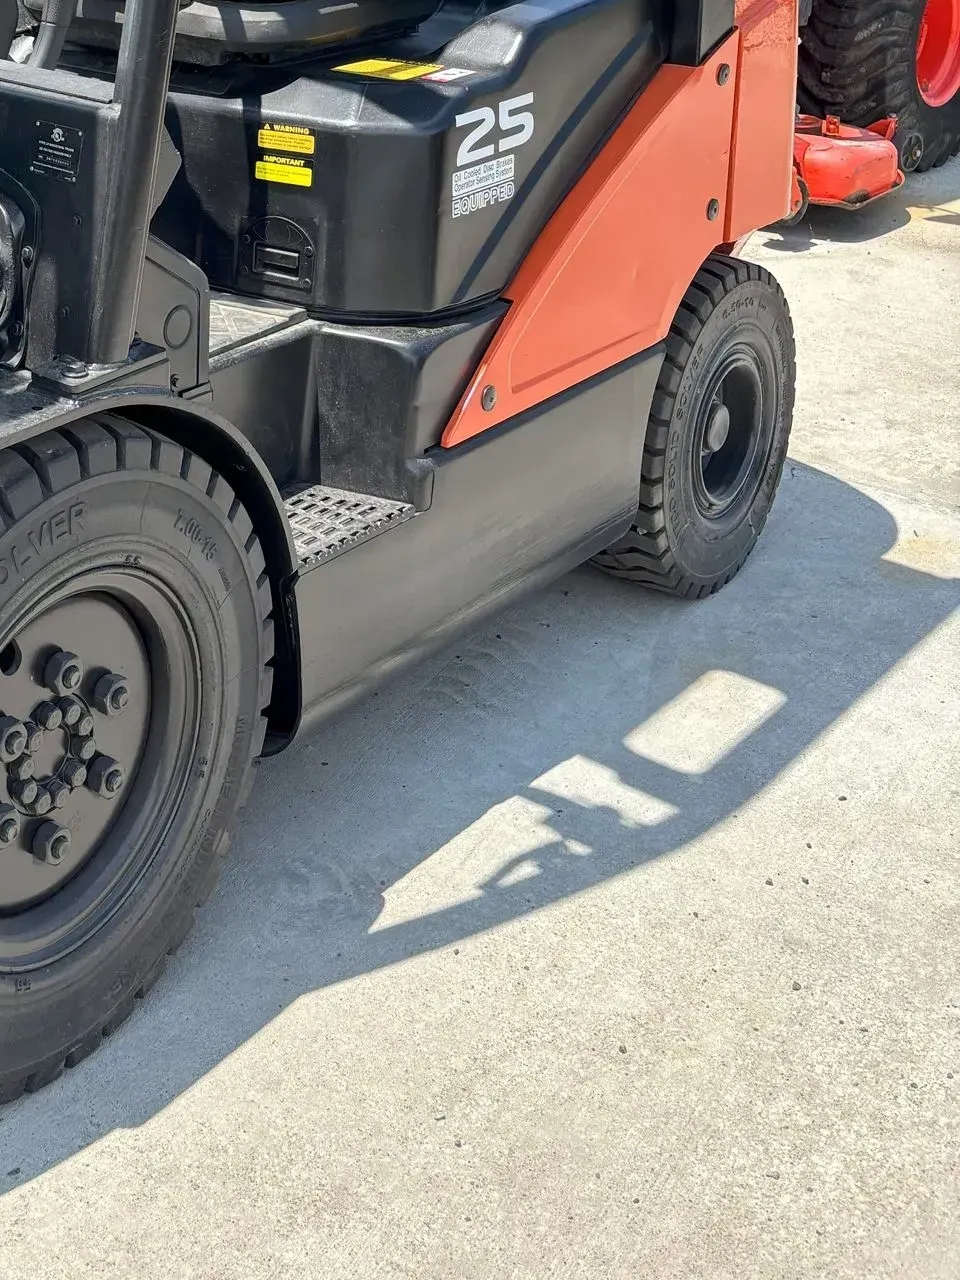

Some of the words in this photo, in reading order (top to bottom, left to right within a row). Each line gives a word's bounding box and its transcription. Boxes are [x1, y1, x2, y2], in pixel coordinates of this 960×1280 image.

[273, 124, 310, 135] WARNING
[455, 91, 535, 167] 25
[263, 155, 305, 167] IMPORTANT
[463, 167, 482, 180] Cooled
[483, 163, 494, 174] Disc
[496, 157, 513, 169] Brakes
[454, 177, 475, 193] Operator
[475, 171, 495, 186] Sensing
[495, 166, 513, 180] System
[452, 181, 515, 218] EQUIPPED
